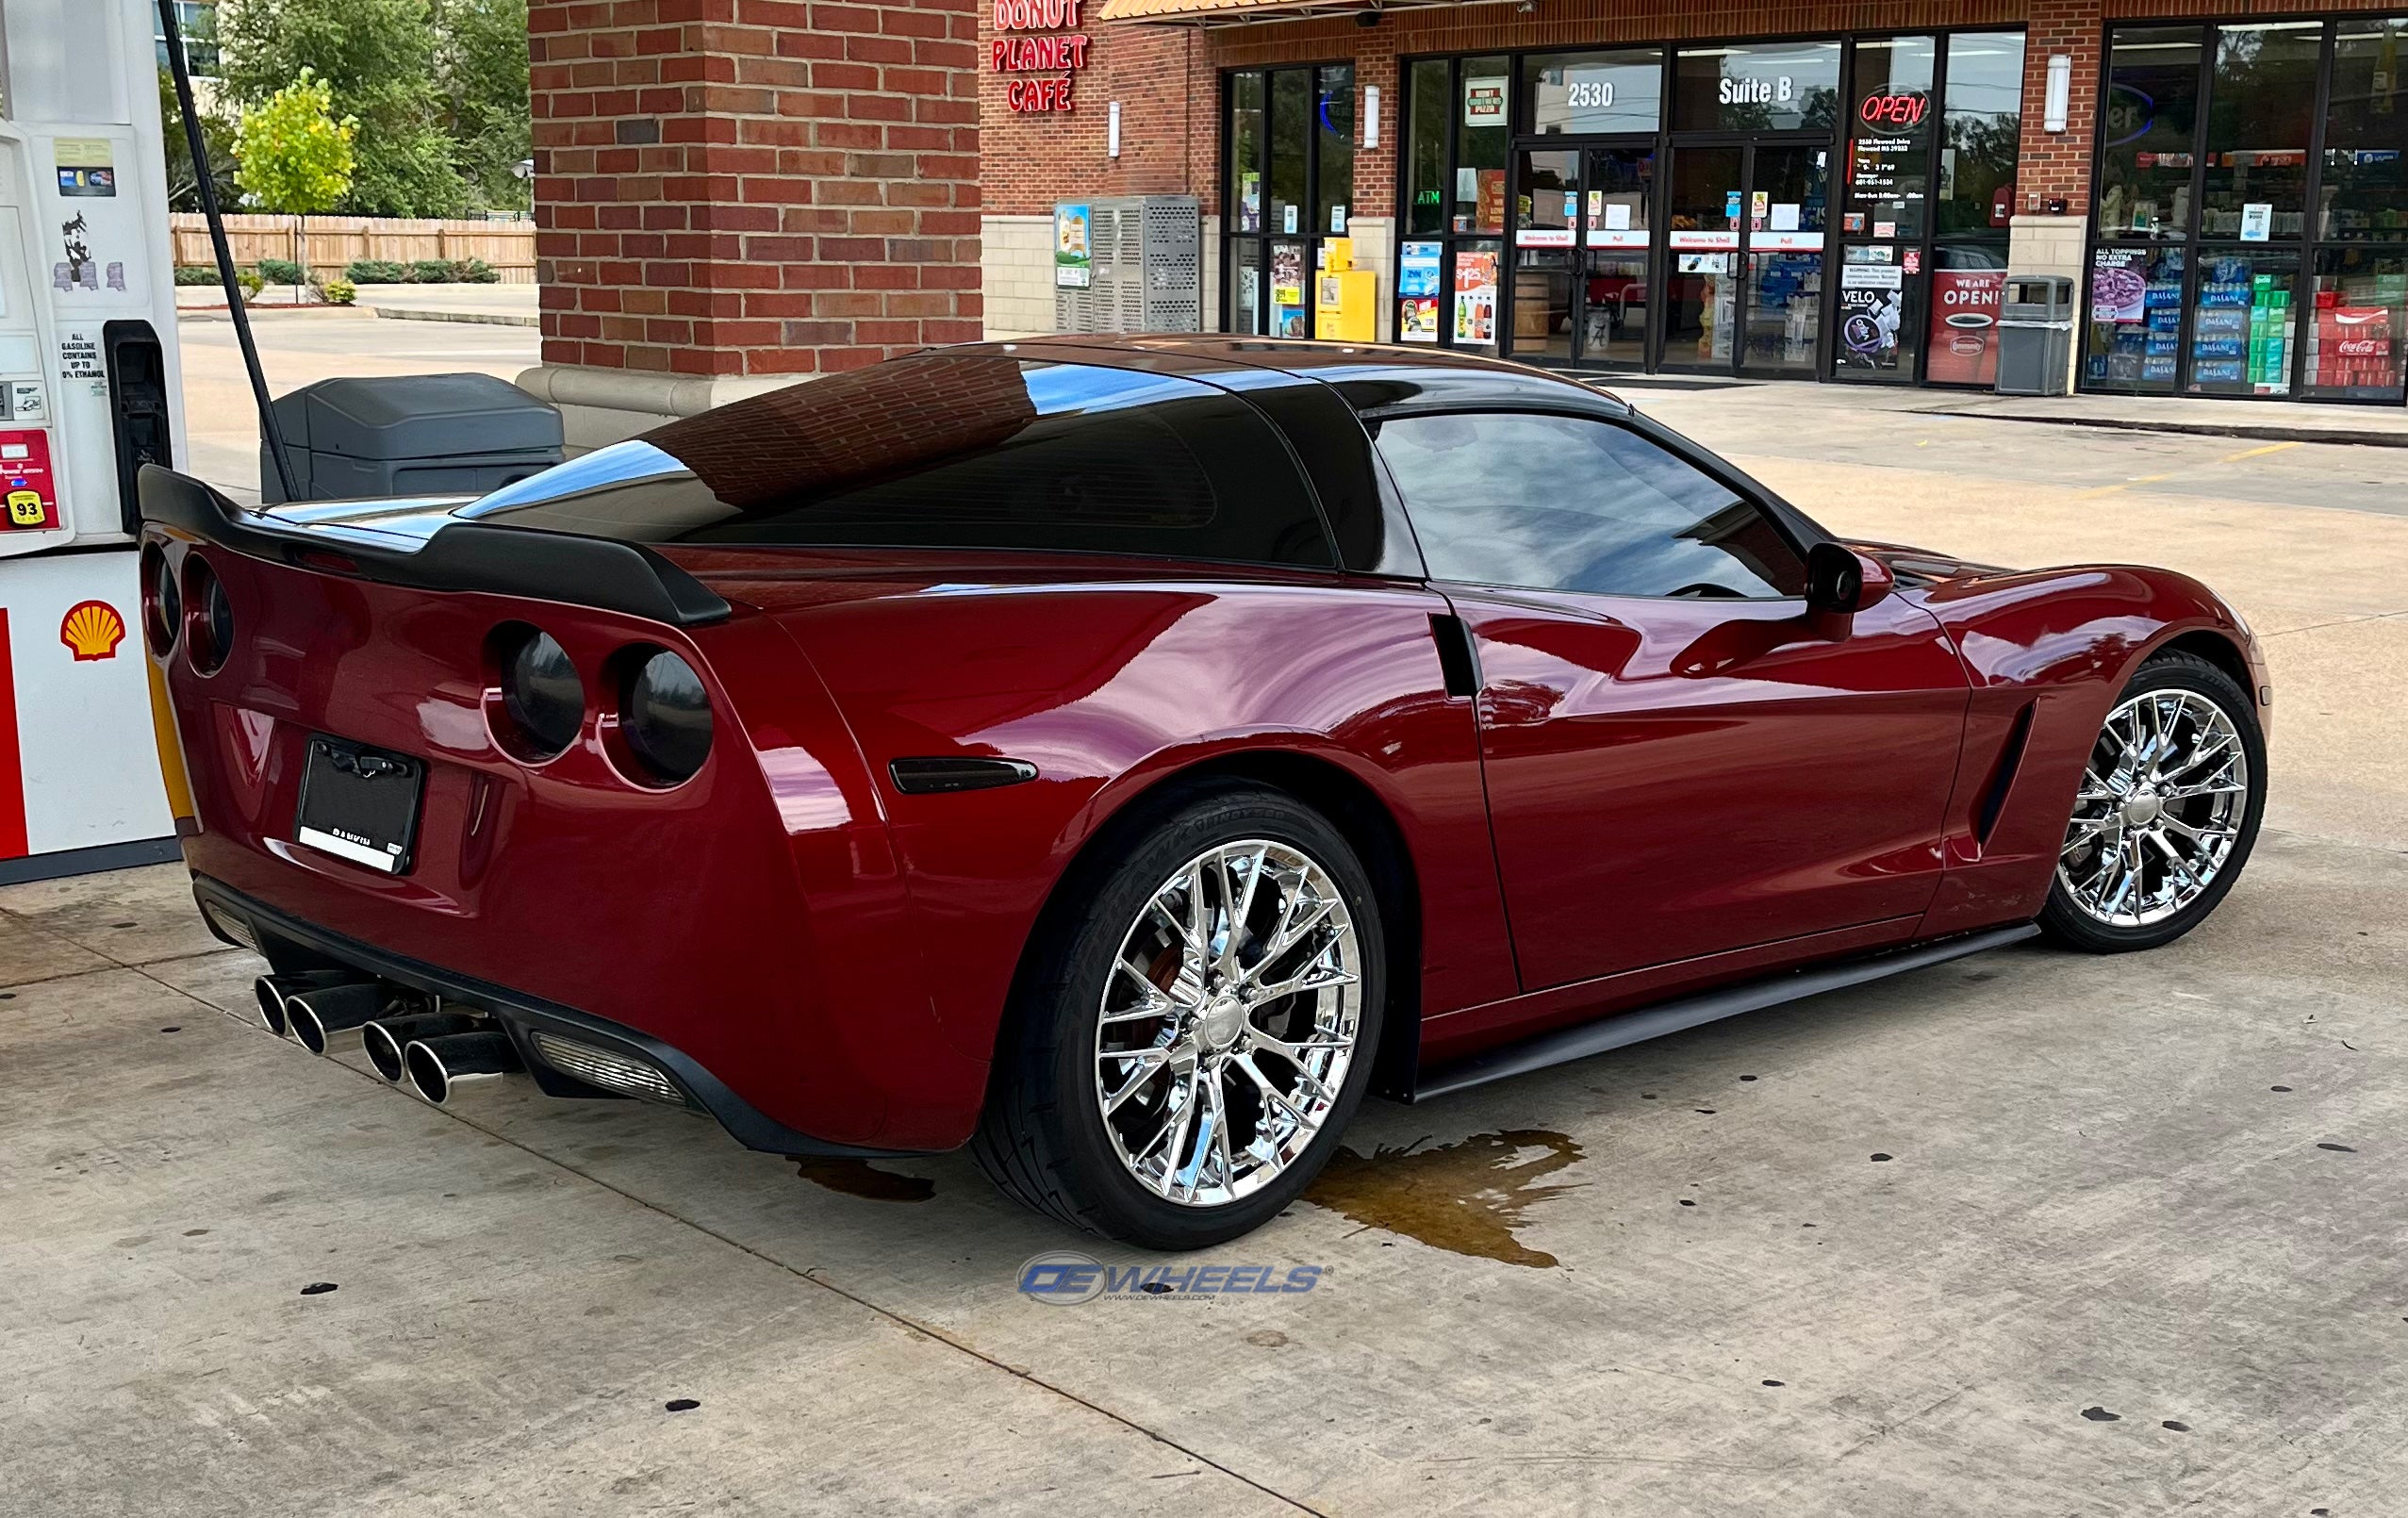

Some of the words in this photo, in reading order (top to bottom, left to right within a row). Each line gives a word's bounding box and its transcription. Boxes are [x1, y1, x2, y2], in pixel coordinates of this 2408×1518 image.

[994, 0, 1081, 30] DONUT
[992, 35, 1088, 72] PLANET
[1007, 71, 1072, 111] CAFÉ
[1567, 82, 1613, 107] 2530
[1719, 77, 1772, 104] Suite
[1777, 76, 1792, 102] B
[1862, 96, 1925, 123] OPEN
[1418, 190, 1440, 204] ATM
[1955, 279, 1971, 288] WE
[1971, 279, 1990, 288] ARE
[1841, 290, 1875, 304] VELO
[1943, 290, 1999, 305] OPEN!
[2205, 318, 2233, 326] DASANI
[2202, 343, 2230, 352] DASANI
[2202, 368, 2231, 377] DASANI
[17, 503, 38, 516] 93
